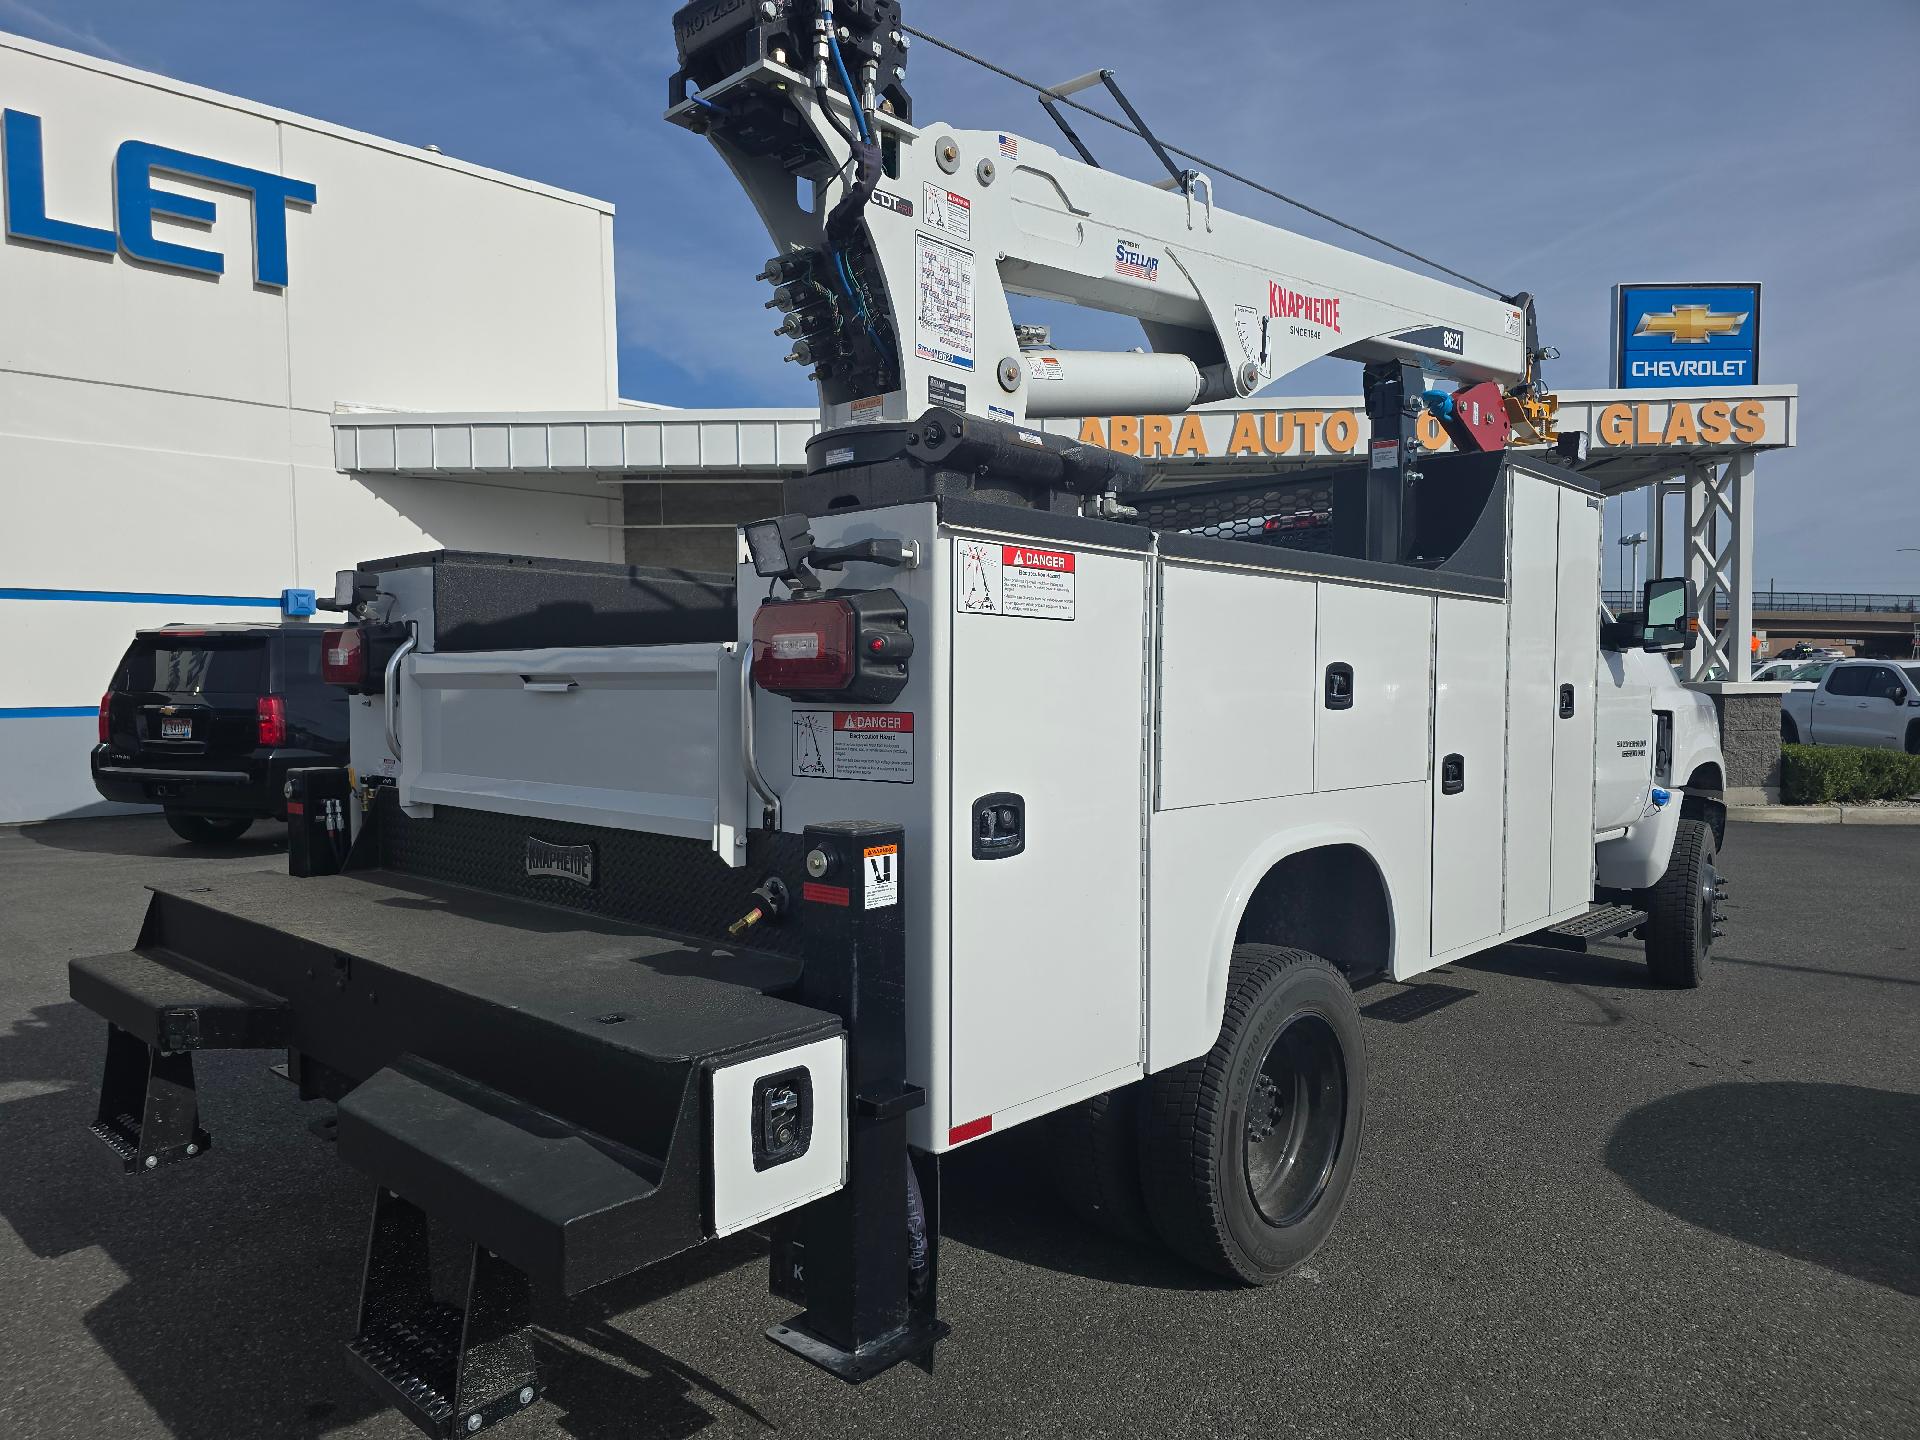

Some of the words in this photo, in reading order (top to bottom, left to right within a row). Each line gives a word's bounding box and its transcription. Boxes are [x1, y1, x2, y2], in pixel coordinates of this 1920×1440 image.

[872, 190, 899, 211] CDT
[897, 203, 912, 216] PRO
[1116, 245, 1158, 271] STELLAR
[1269, 280, 1341, 333] KNAPHEIDE
[1289, 325, 1308, 337] SINCE
[1443, 331, 1460, 350] 8621
[1632, 360, 1746, 377] CHEVROLET
[1078, 411, 1209, 456] ABRA
[1229, 410, 1360, 453] AUTO
[1600, 401, 1766, 445] GLASS
[1026, 553, 1064, 568] DANGER
[857, 716, 900, 728] DANGER
[526, 839, 589, 879] KNAPHEIDE
